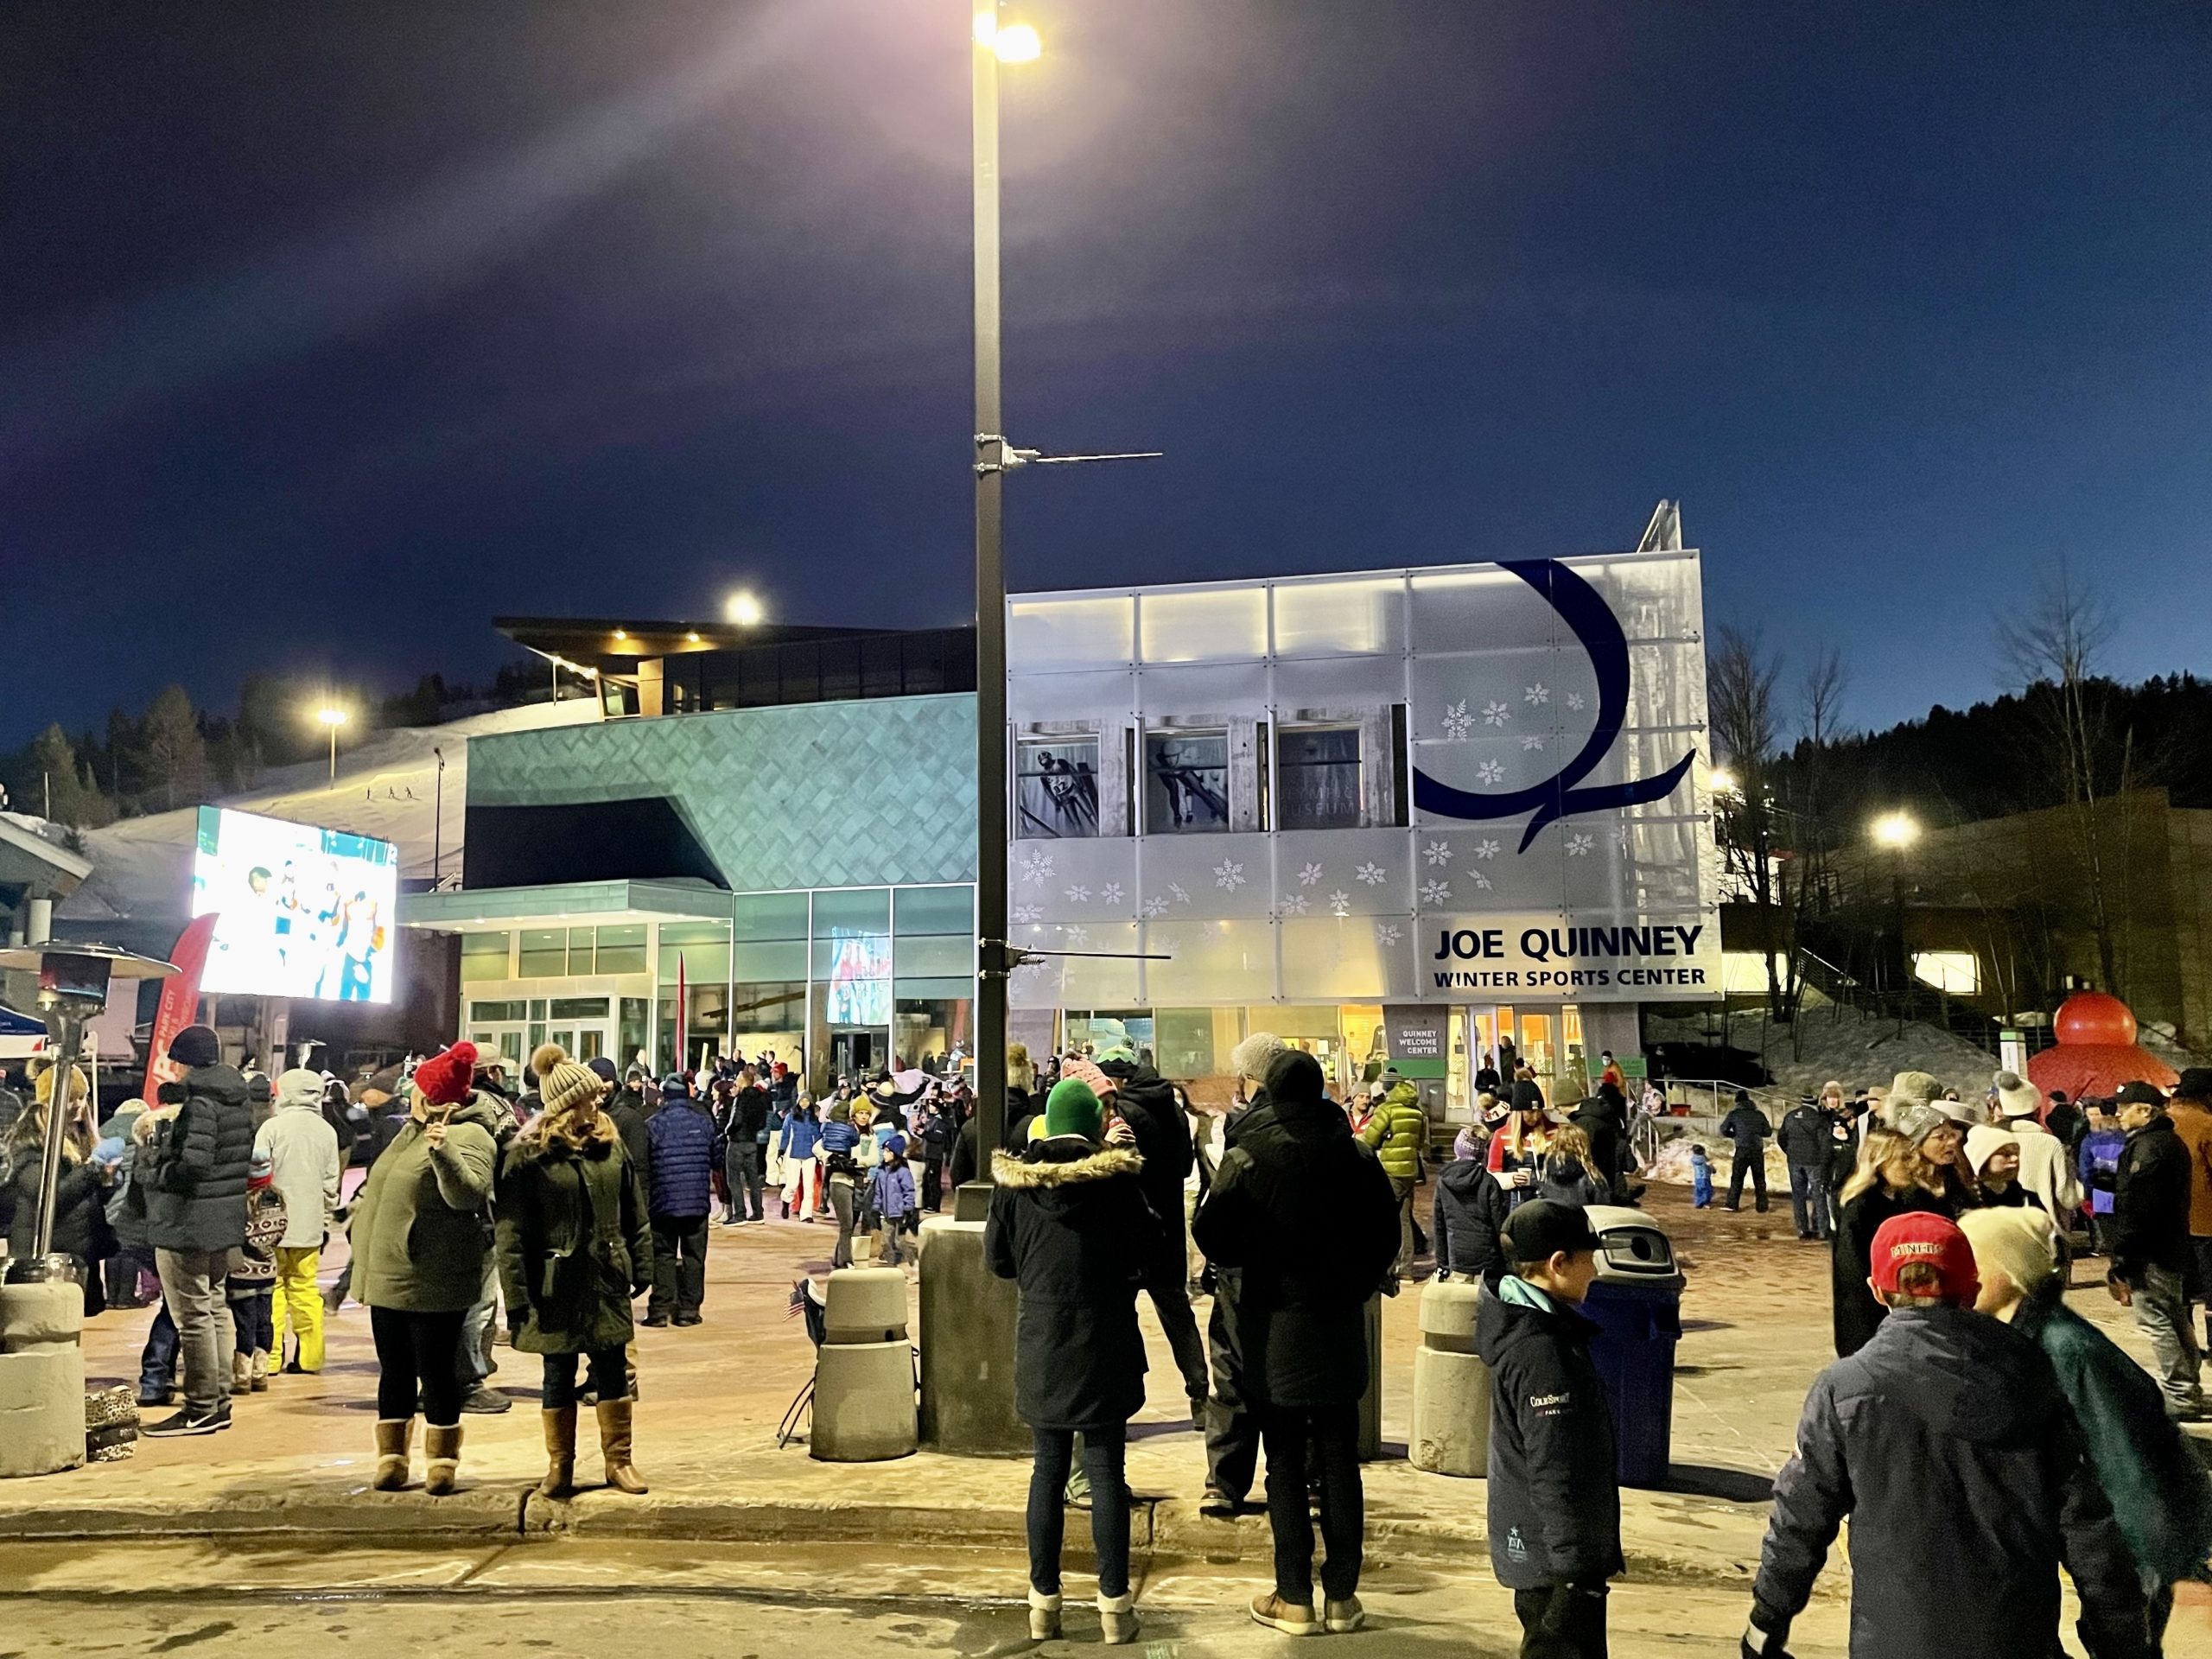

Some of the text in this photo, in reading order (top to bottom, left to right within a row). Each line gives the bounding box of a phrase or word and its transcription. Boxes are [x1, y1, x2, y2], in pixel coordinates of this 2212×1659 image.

[1434, 925, 1704, 963] JOE QUINNEY
[1433, 968, 1706, 988] WINTER SPORTS CENTER
[159, 989, 175, 1038] PARK CITY
